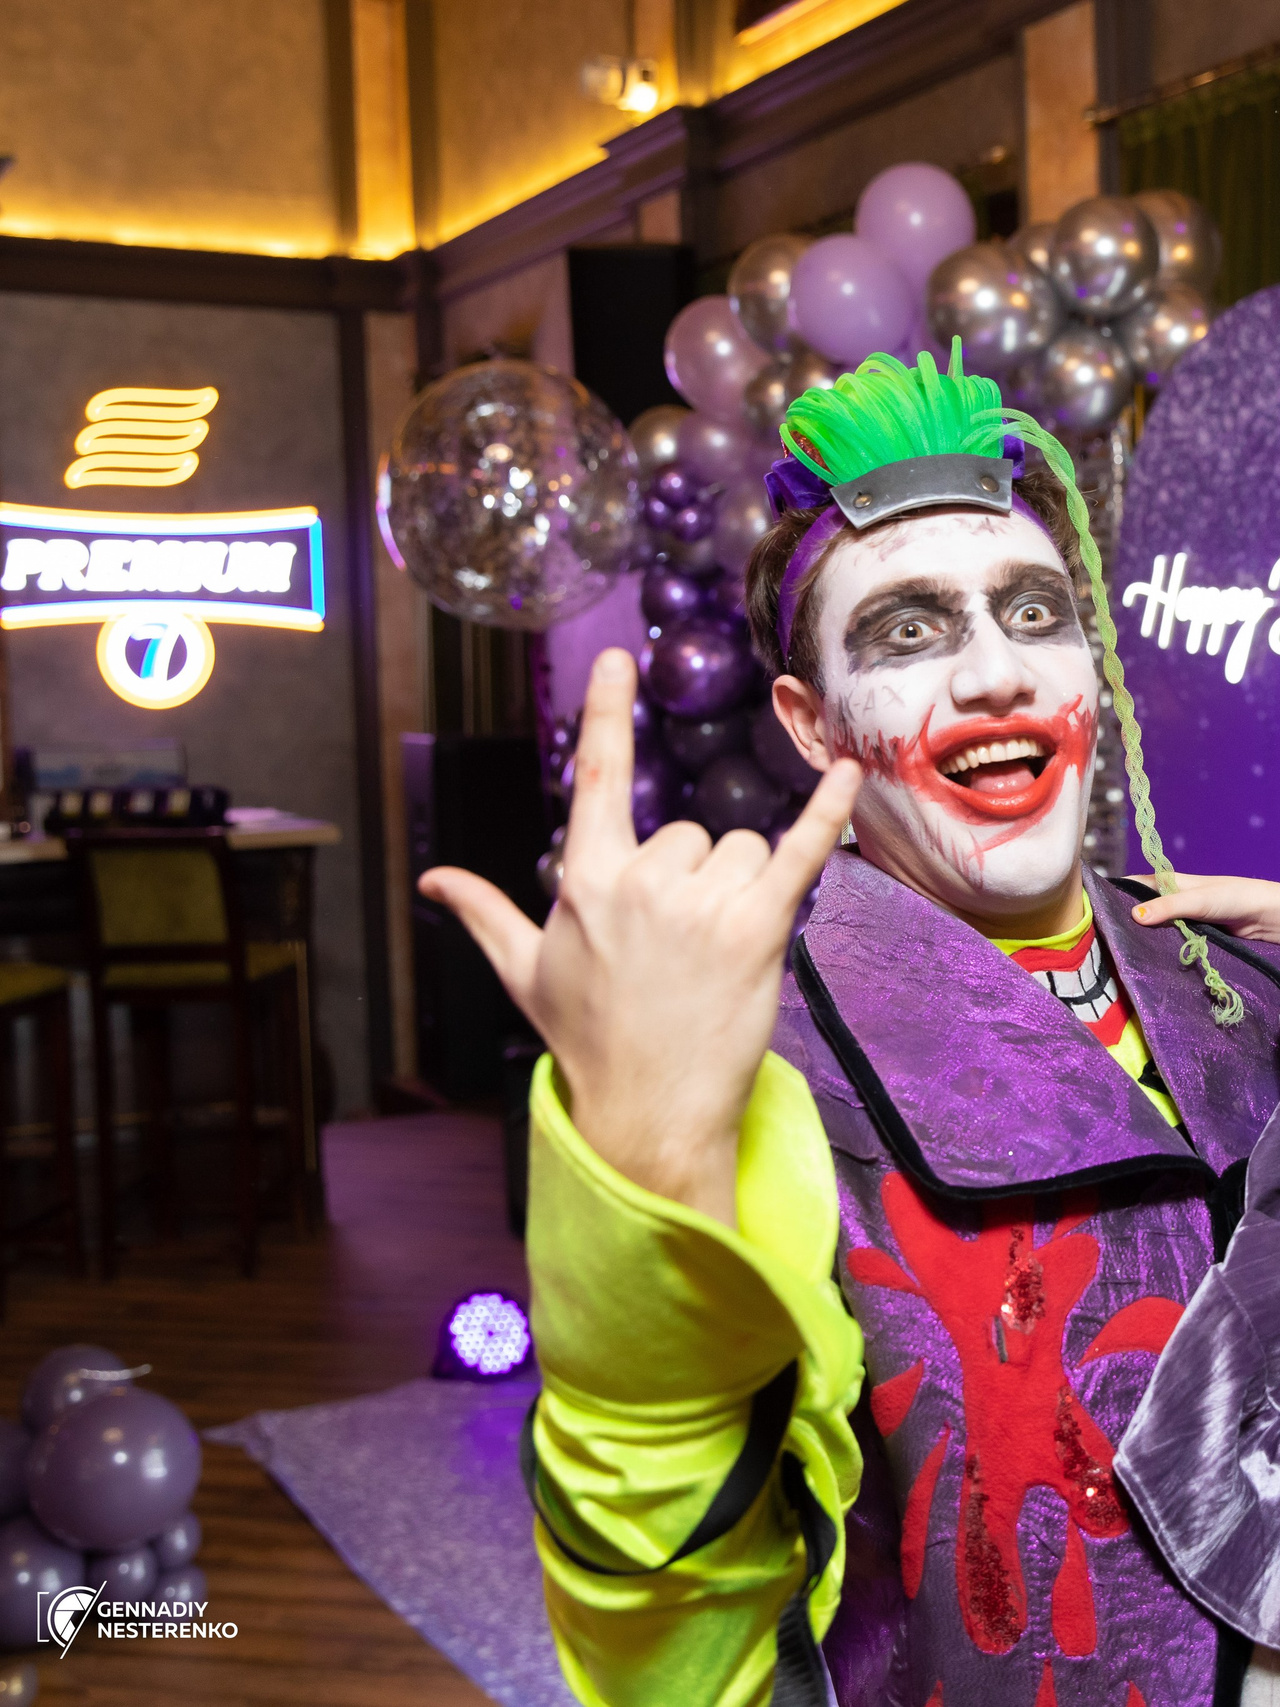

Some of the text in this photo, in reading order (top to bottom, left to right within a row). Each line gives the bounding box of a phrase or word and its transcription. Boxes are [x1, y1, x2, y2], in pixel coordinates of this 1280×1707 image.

[1, 538, 297, 593] PREMIUM
[1122, 552, 1275, 684] Happy
[127, 622, 185, 682] 7
